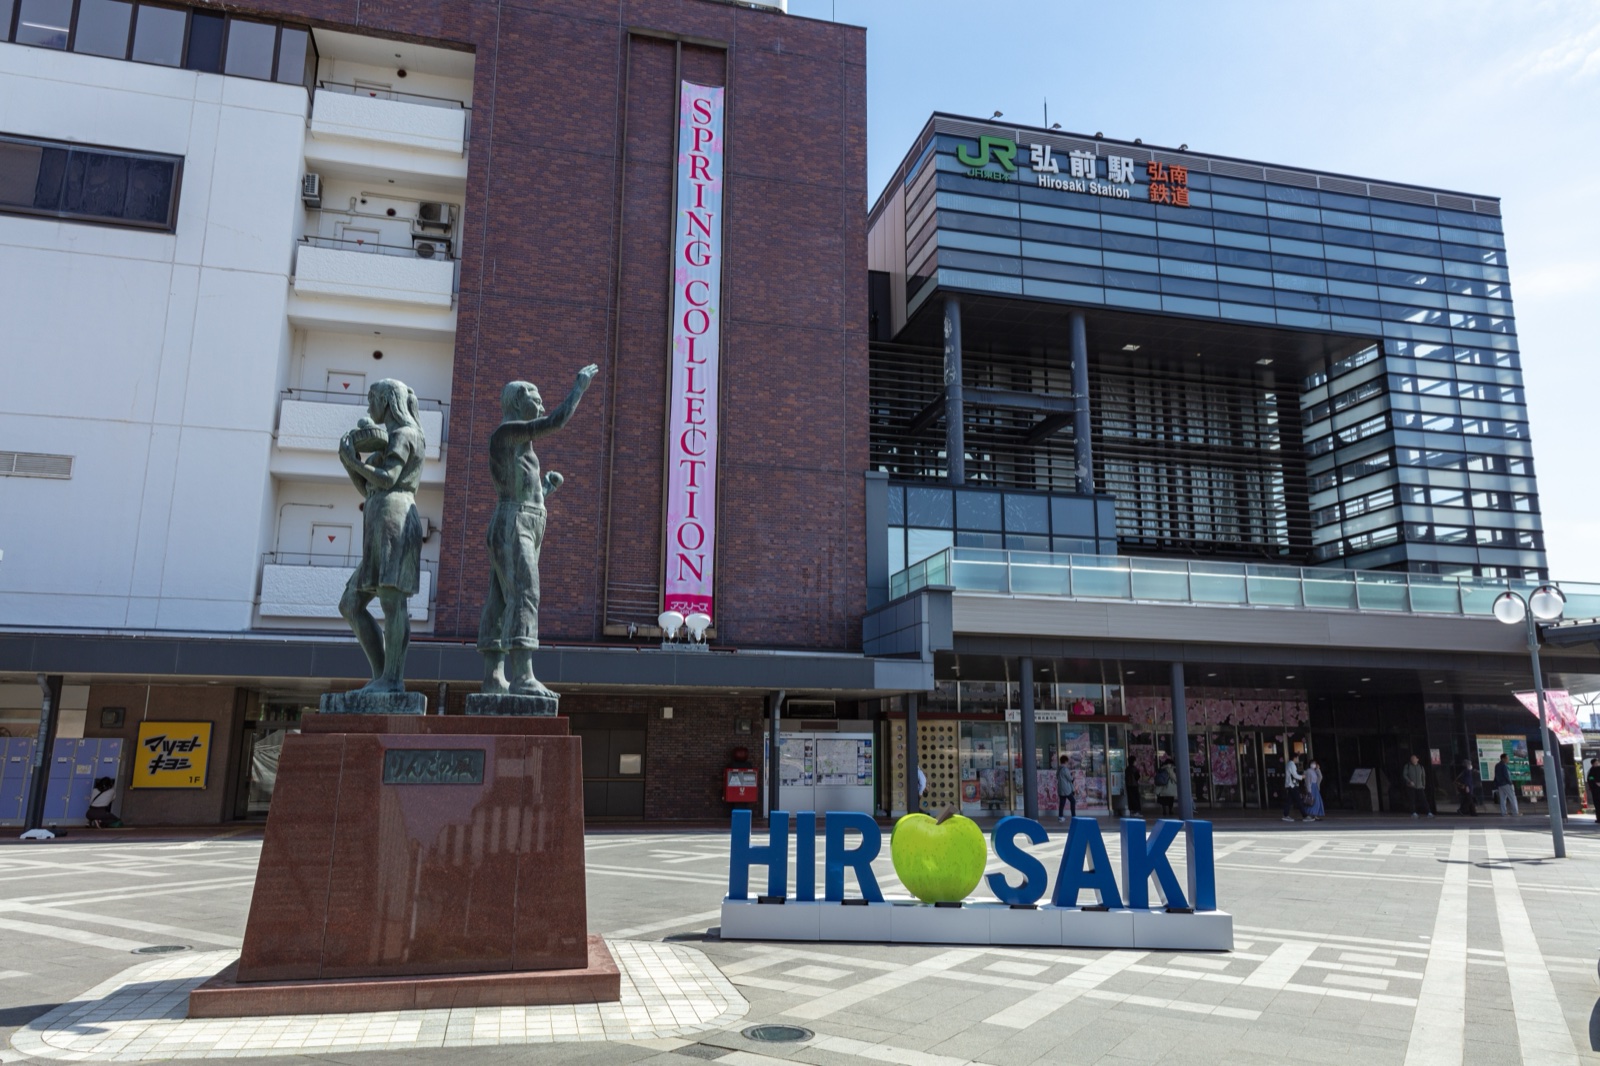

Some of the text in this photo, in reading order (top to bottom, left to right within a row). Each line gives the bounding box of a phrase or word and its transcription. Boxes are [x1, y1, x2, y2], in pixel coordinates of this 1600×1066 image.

[957, 135, 1017, 171] JR
[1030, 144, 1136, 184] 弘前駅
[685, 98, 714, 267] SPRING
[1148, 161, 1189, 185] 弘南
[1038, 174, 1130, 199] Hirosaki Station
[1149, 182, 1190, 207] 鉄道
[676, 280, 710, 582] COLLECTION
[144, 735, 202, 756] マツモト
[149, 754, 192, 775] キヨシ
[189, 776, 201, 784] 1F
